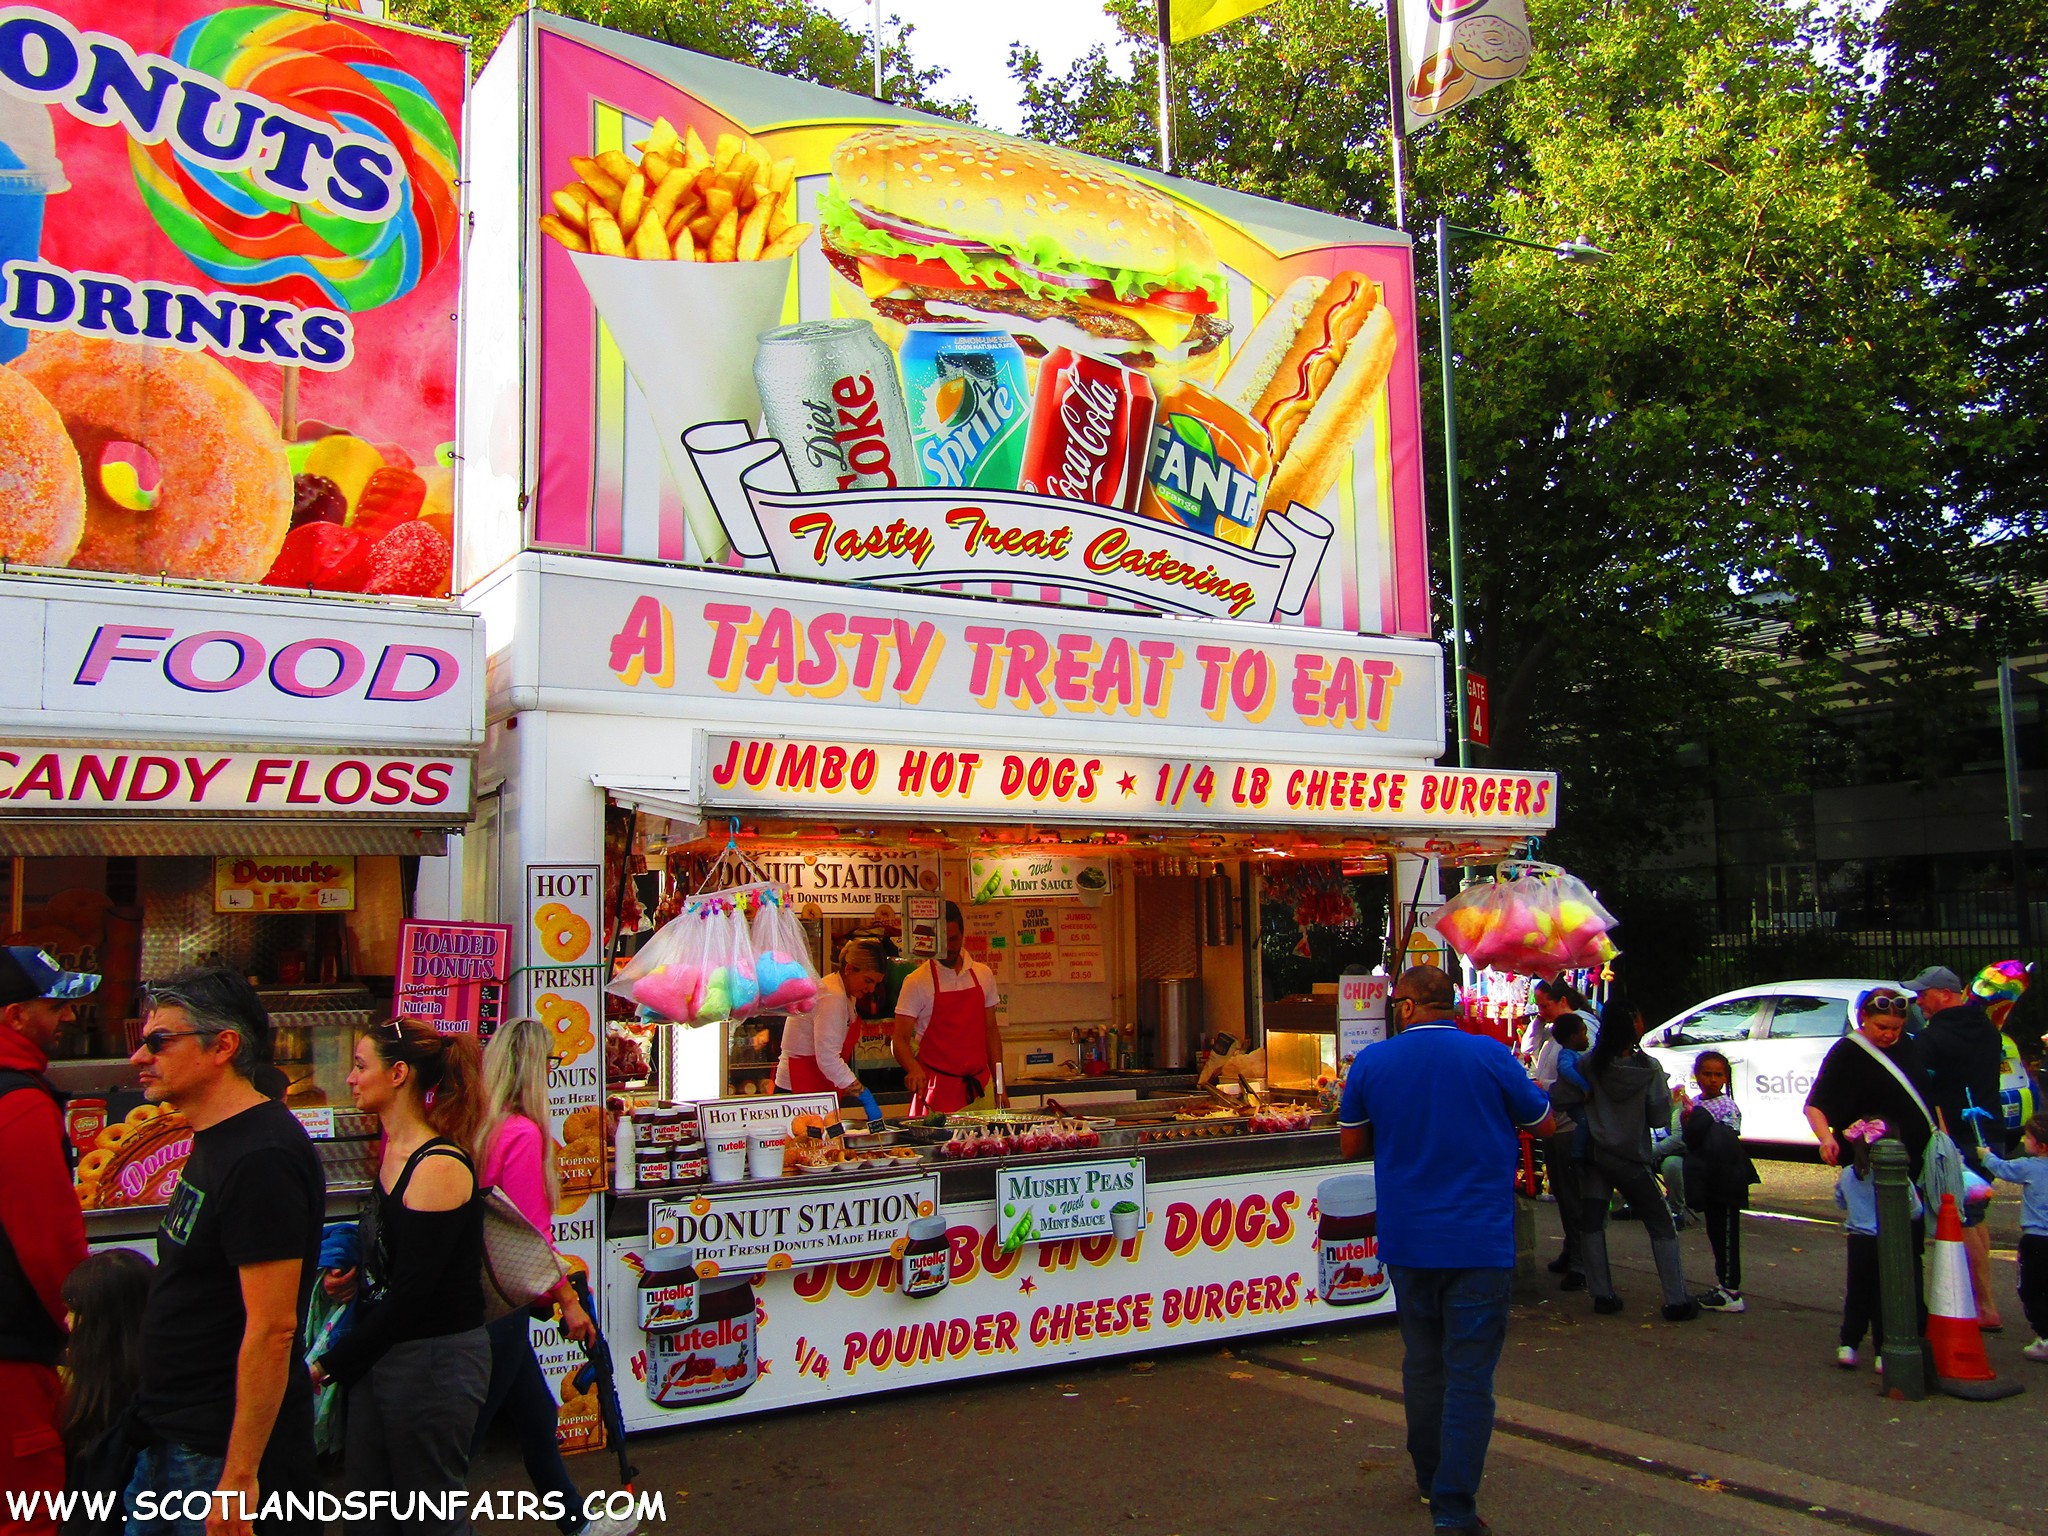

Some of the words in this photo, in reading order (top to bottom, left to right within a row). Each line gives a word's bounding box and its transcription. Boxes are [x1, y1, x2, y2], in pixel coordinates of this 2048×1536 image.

[10, 266, 347, 365] DRINKS
[802, 399, 849, 472] Diet
[922, 381, 1015, 488] Sprite
[1157, 484, 1200, 515] Orange
[789, 504, 933, 570] Tasty
[946, 507, 1073, 562] Treat
[1083, 526, 1260, 616] Catering
[74, 623, 460, 702] FOOD
[609, 595, 668, 685] A
[704, 601, 934, 698] TASTY
[965, 625, 1189, 712] TREAT
[1197, 644, 1272, 720] TO
[1292, 653, 1402, 728] EAT
[1467, 679, 1485, 701] GATE
[1472, 704, 1483, 738] 4
[246, 759, 455, 805] FLOSS
[712, 740, 879, 794] JUMBO
[898, 750, 981, 796] HOT
[1000, 756, 1103, 802] DOGS
[1156, 763, 1217, 807] 1/4
[1232, 767, 1273, 808] LB
[1286, 768, 1407, 813] CHEESE
[1420, 774, 1552, 818] BURGERS
[233, 859, 336, 884] Donuts
[813, 863, 920, 889] STATION
[1028, 859, 1054, 877] With
[536, 874, 593, 898] HOT
[1010, 879, 1040, 891] MINT
[1041, 878, 1073, 890] SAUCE
[268, 893, 301, 910] For
[798, 892, 838, 904] DONUTS
[841, 892, 872, 904] MADE
[874, 892, 901, 904] HERE
[1022, 918, 1049, 929] DRINKS
[1025, 909, 1044, 919] COLD
[1065, 913, 1092, 921] JUMBO
[412, 932, 498, 956] LOADED
[411, 955, 495, 979] DONUTS
[1024, 969, 1052, 979] £2.00
[533, 967, 596, 990] FRESH
[404, 983, 449, 998] Sugared
[1344, 981, 1384, 1000] CHIPS
[403, 1001, 442, 1014] Nutella
[433, 1019, 470, 1032] Biscoff
[547, 1067, 597, 1089] ONUTS
[547, 1097, 566, 1105] ADE
[568, 1092, 597, 1104] HERE
[549, 1108, 571, 1117] ERY
[573, 1106, 592, 1115] DAY
[709, 1109, 737, 1124] HOT
[739, 1106, 780, 1122] FRESH
[781, 1103, 830, 1119] DONUTS
[653, 1125, 680, 1134] nutella
[681, 1121, 698, 1129] tella
[558, 1156, 599, 1167] TOPPING
[641, 1163, 668, 1172] nutella
[676, 1160, 701, 1170] nutella
[1008, 1176, 1083, 1202] MUSHY
[1085, 1171, 1134, 1194] PEAS
[656, 1206, 679, 1223] The
[1060, 1196, 1085, 1216] With
[676, 1206, 791, 1245] DONUT
[798, 1191, 922, 1234] STATION
[1039, 1215, 1069, 1232] MINT
[1071, 1213, 1106, 1229] SAUCE
[1164, 1190, 1300, 1256] DOGS
[695, 1246, 726, 1261] HOT
[728, 1244, 770, 1257] FRESH
[773, 1238, 825, 1253] DONUTS
[827, 1232, 864, 1247] MADE
[866, 1228, 899, 1241] HERE
[909, 1251, 946, 1269] nutella
[646, 1283, 694, 1303] nutella
[659, 1319, 748, 1353] nutella
[795, 1336, 829, 1380] 1/4
[843, 1318, 1019, 1372] POUNDER
[1029, 1293, 1152, 1344] CHEESE
[1163, 1272, 1301, 1322] BURGERS
[543, 1365, 569, 1376] VERY
